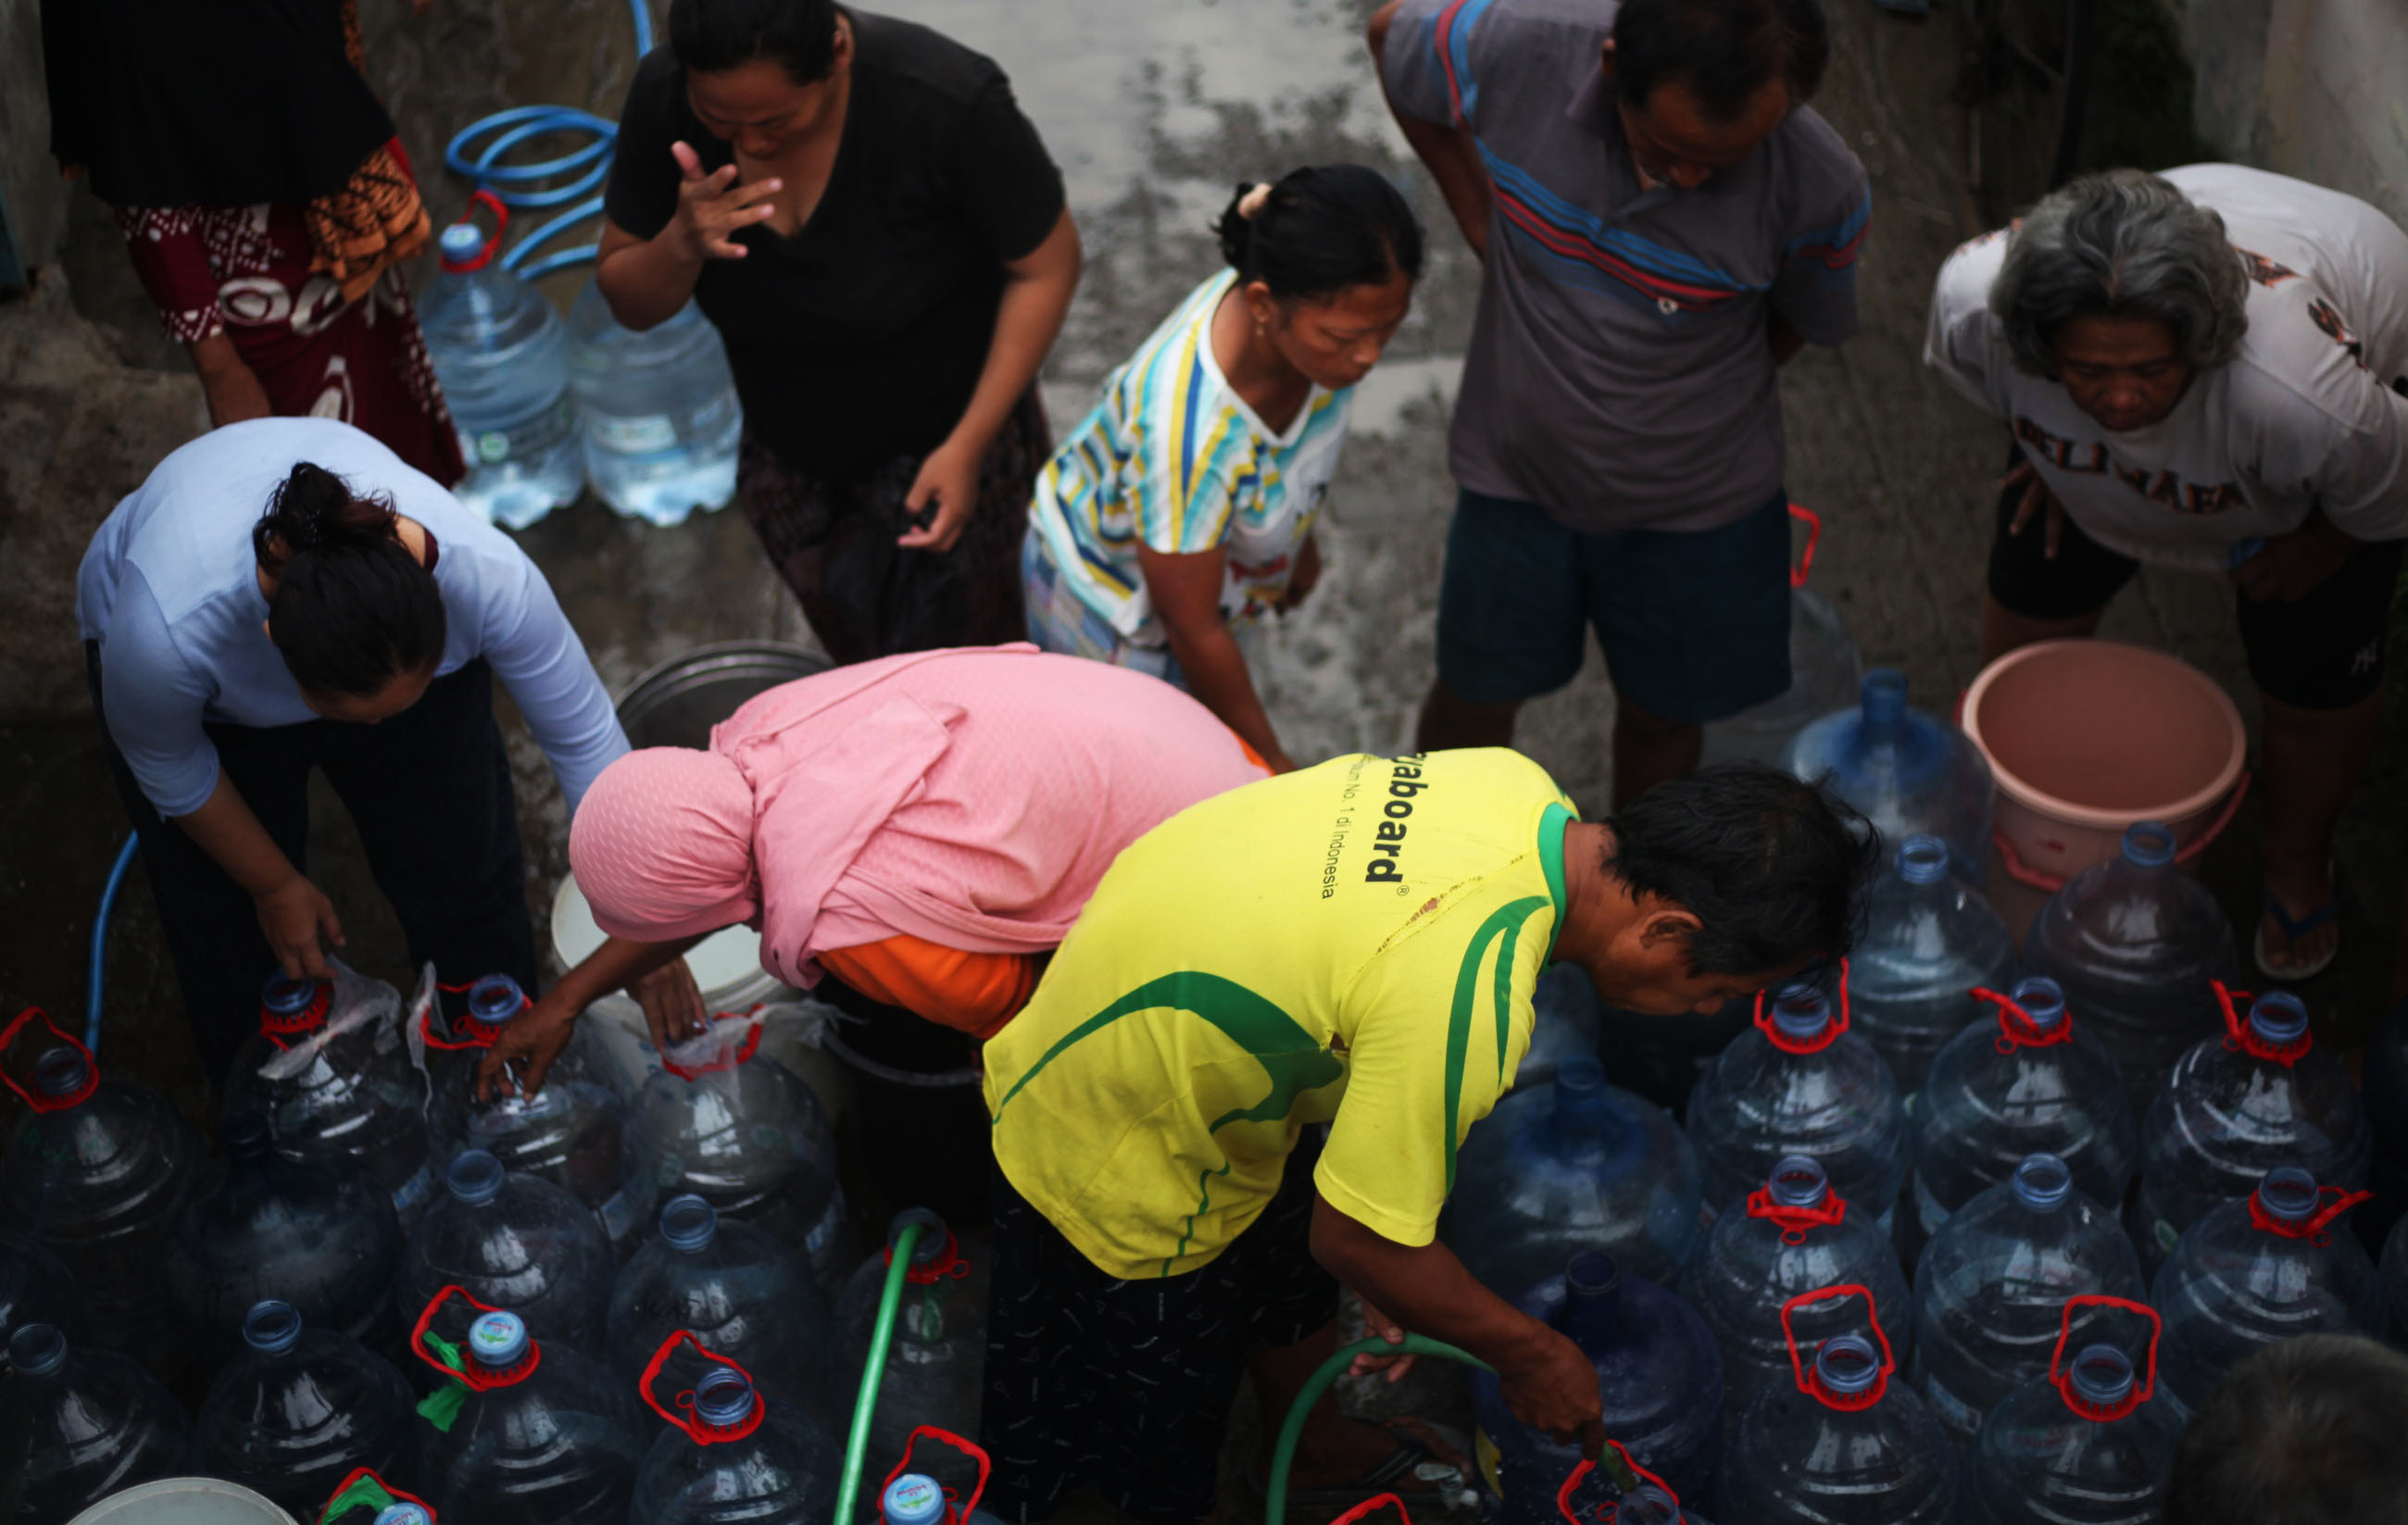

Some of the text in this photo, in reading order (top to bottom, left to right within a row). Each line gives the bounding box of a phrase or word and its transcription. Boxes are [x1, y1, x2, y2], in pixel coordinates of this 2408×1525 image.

[1342, 782, 1361, 803] No.
[1336, 816, 1352, 829] di
[1322, 831, 1349, 900] Indonesia
